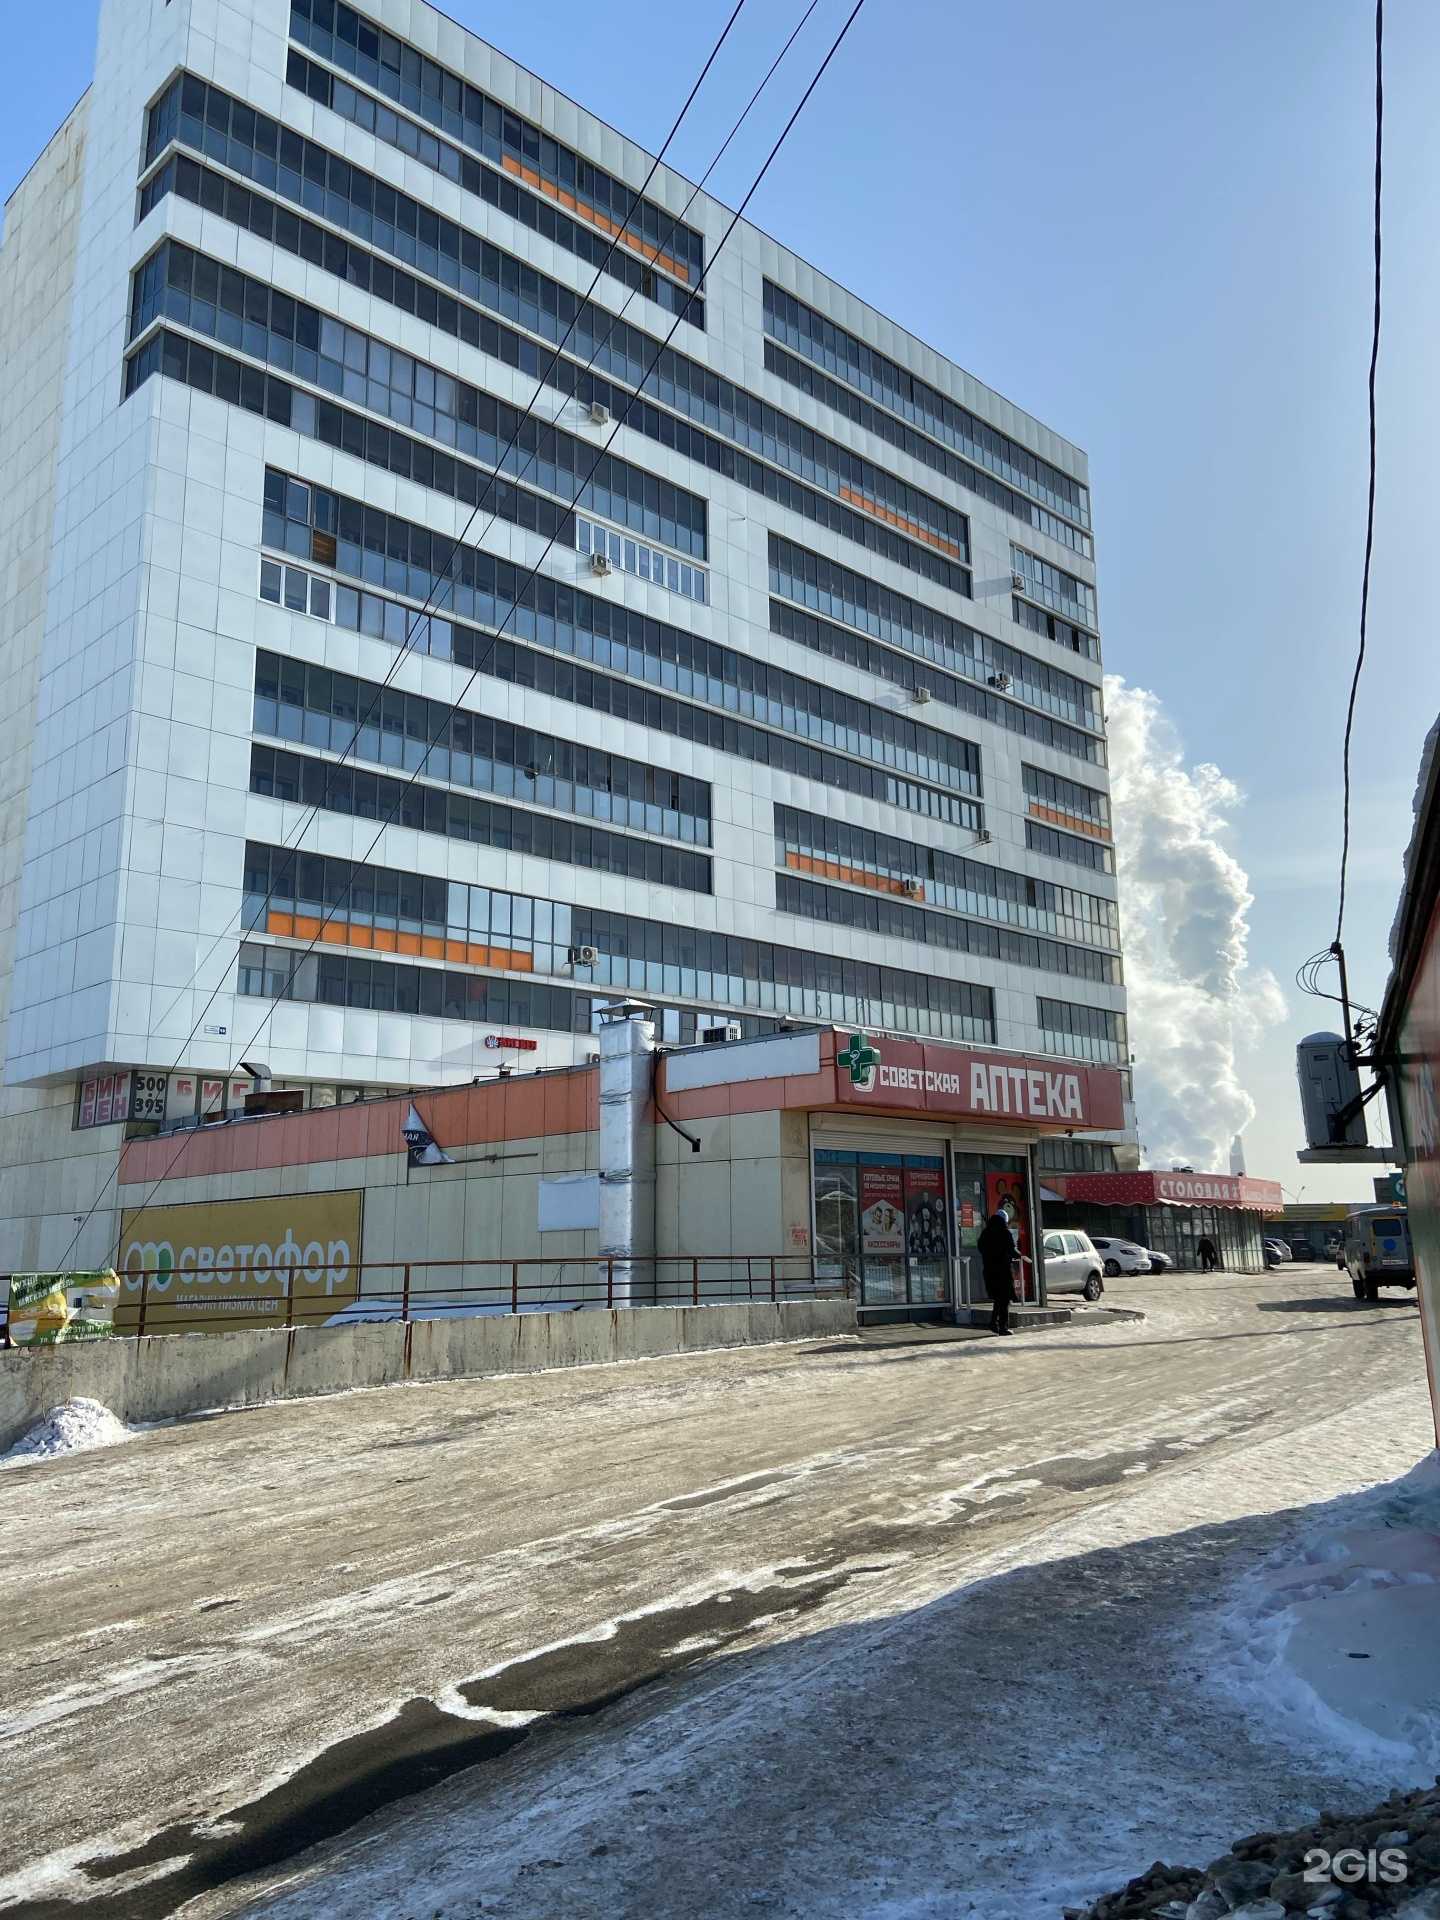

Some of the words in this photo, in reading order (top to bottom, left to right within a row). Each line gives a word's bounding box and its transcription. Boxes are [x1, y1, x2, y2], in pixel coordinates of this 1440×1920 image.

[879, 1065, 960, 1094] СОВЕТСКАЯ
[970, 1062, 1083, 1120] АПТЕКА
[1160, 1180, 1230, 1200] СТОЛОВАЯ
